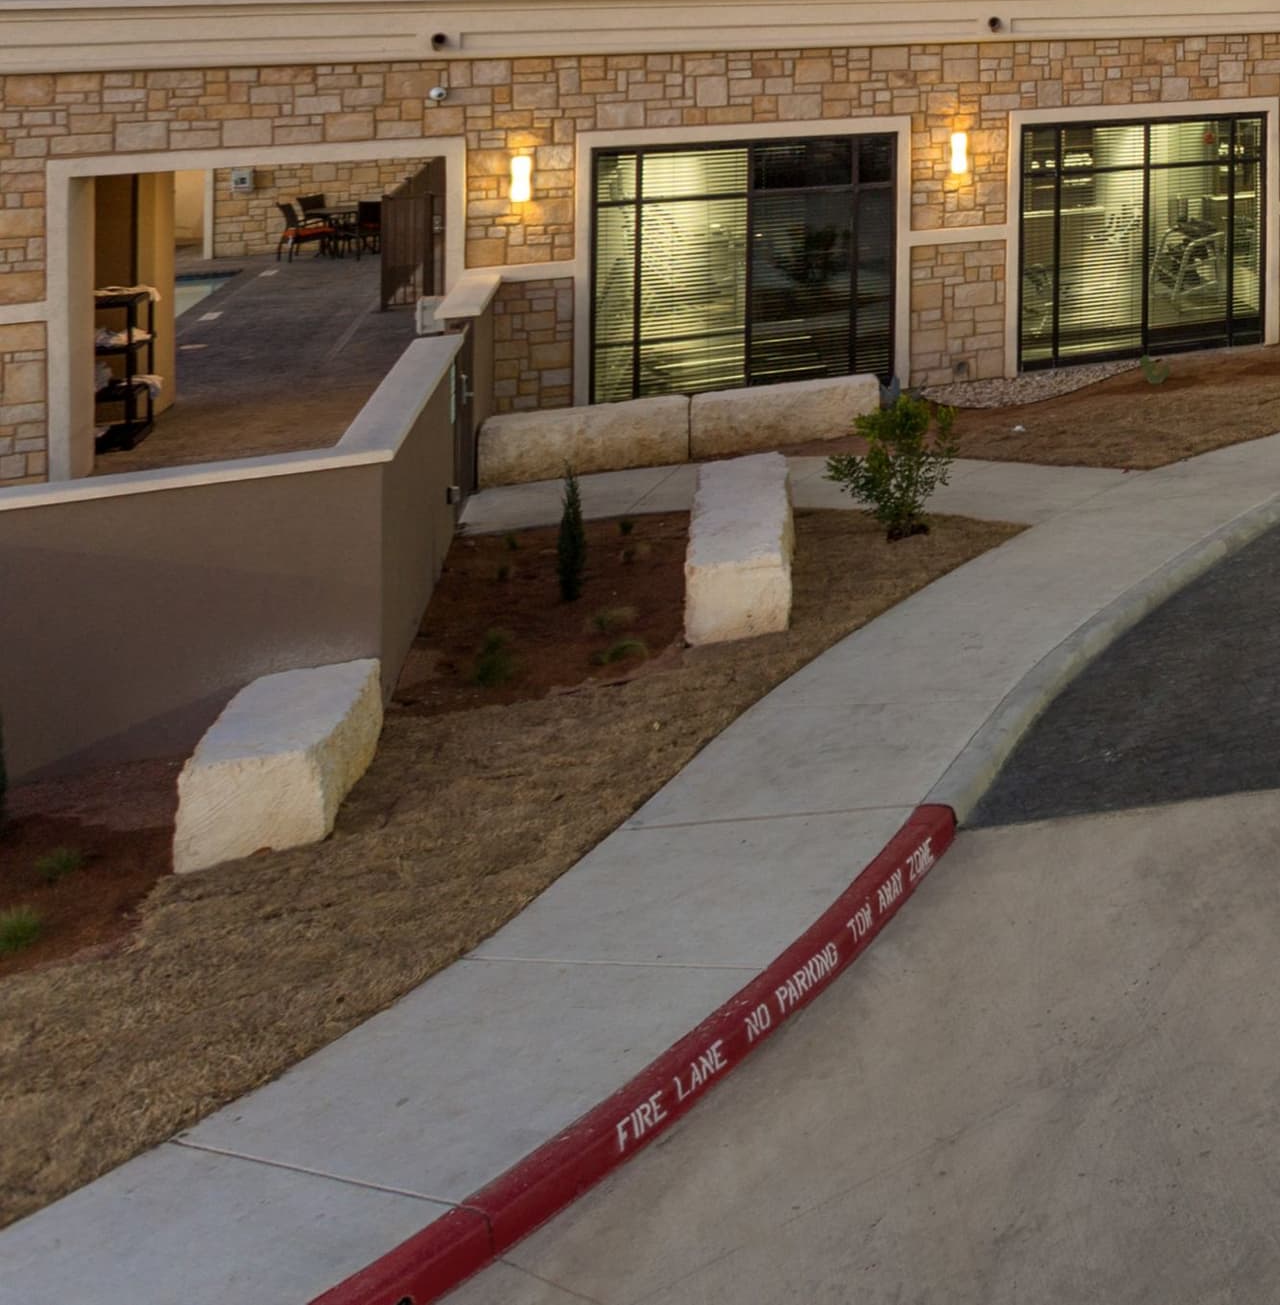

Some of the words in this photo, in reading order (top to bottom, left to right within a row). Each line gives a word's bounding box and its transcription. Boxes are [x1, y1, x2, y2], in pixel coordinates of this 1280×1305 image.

[616, 1090, 668, 1152] FIRE
[673, 1039, 728, 1101] LANE
[744, 1003, 771, 1043] NO
[774, 942, 838, 1014] PARKING
[846, 902, 873, 943] TOW
[877, 868, 904, 913] AWAY
[906, 836, 935, 882] ZONE
